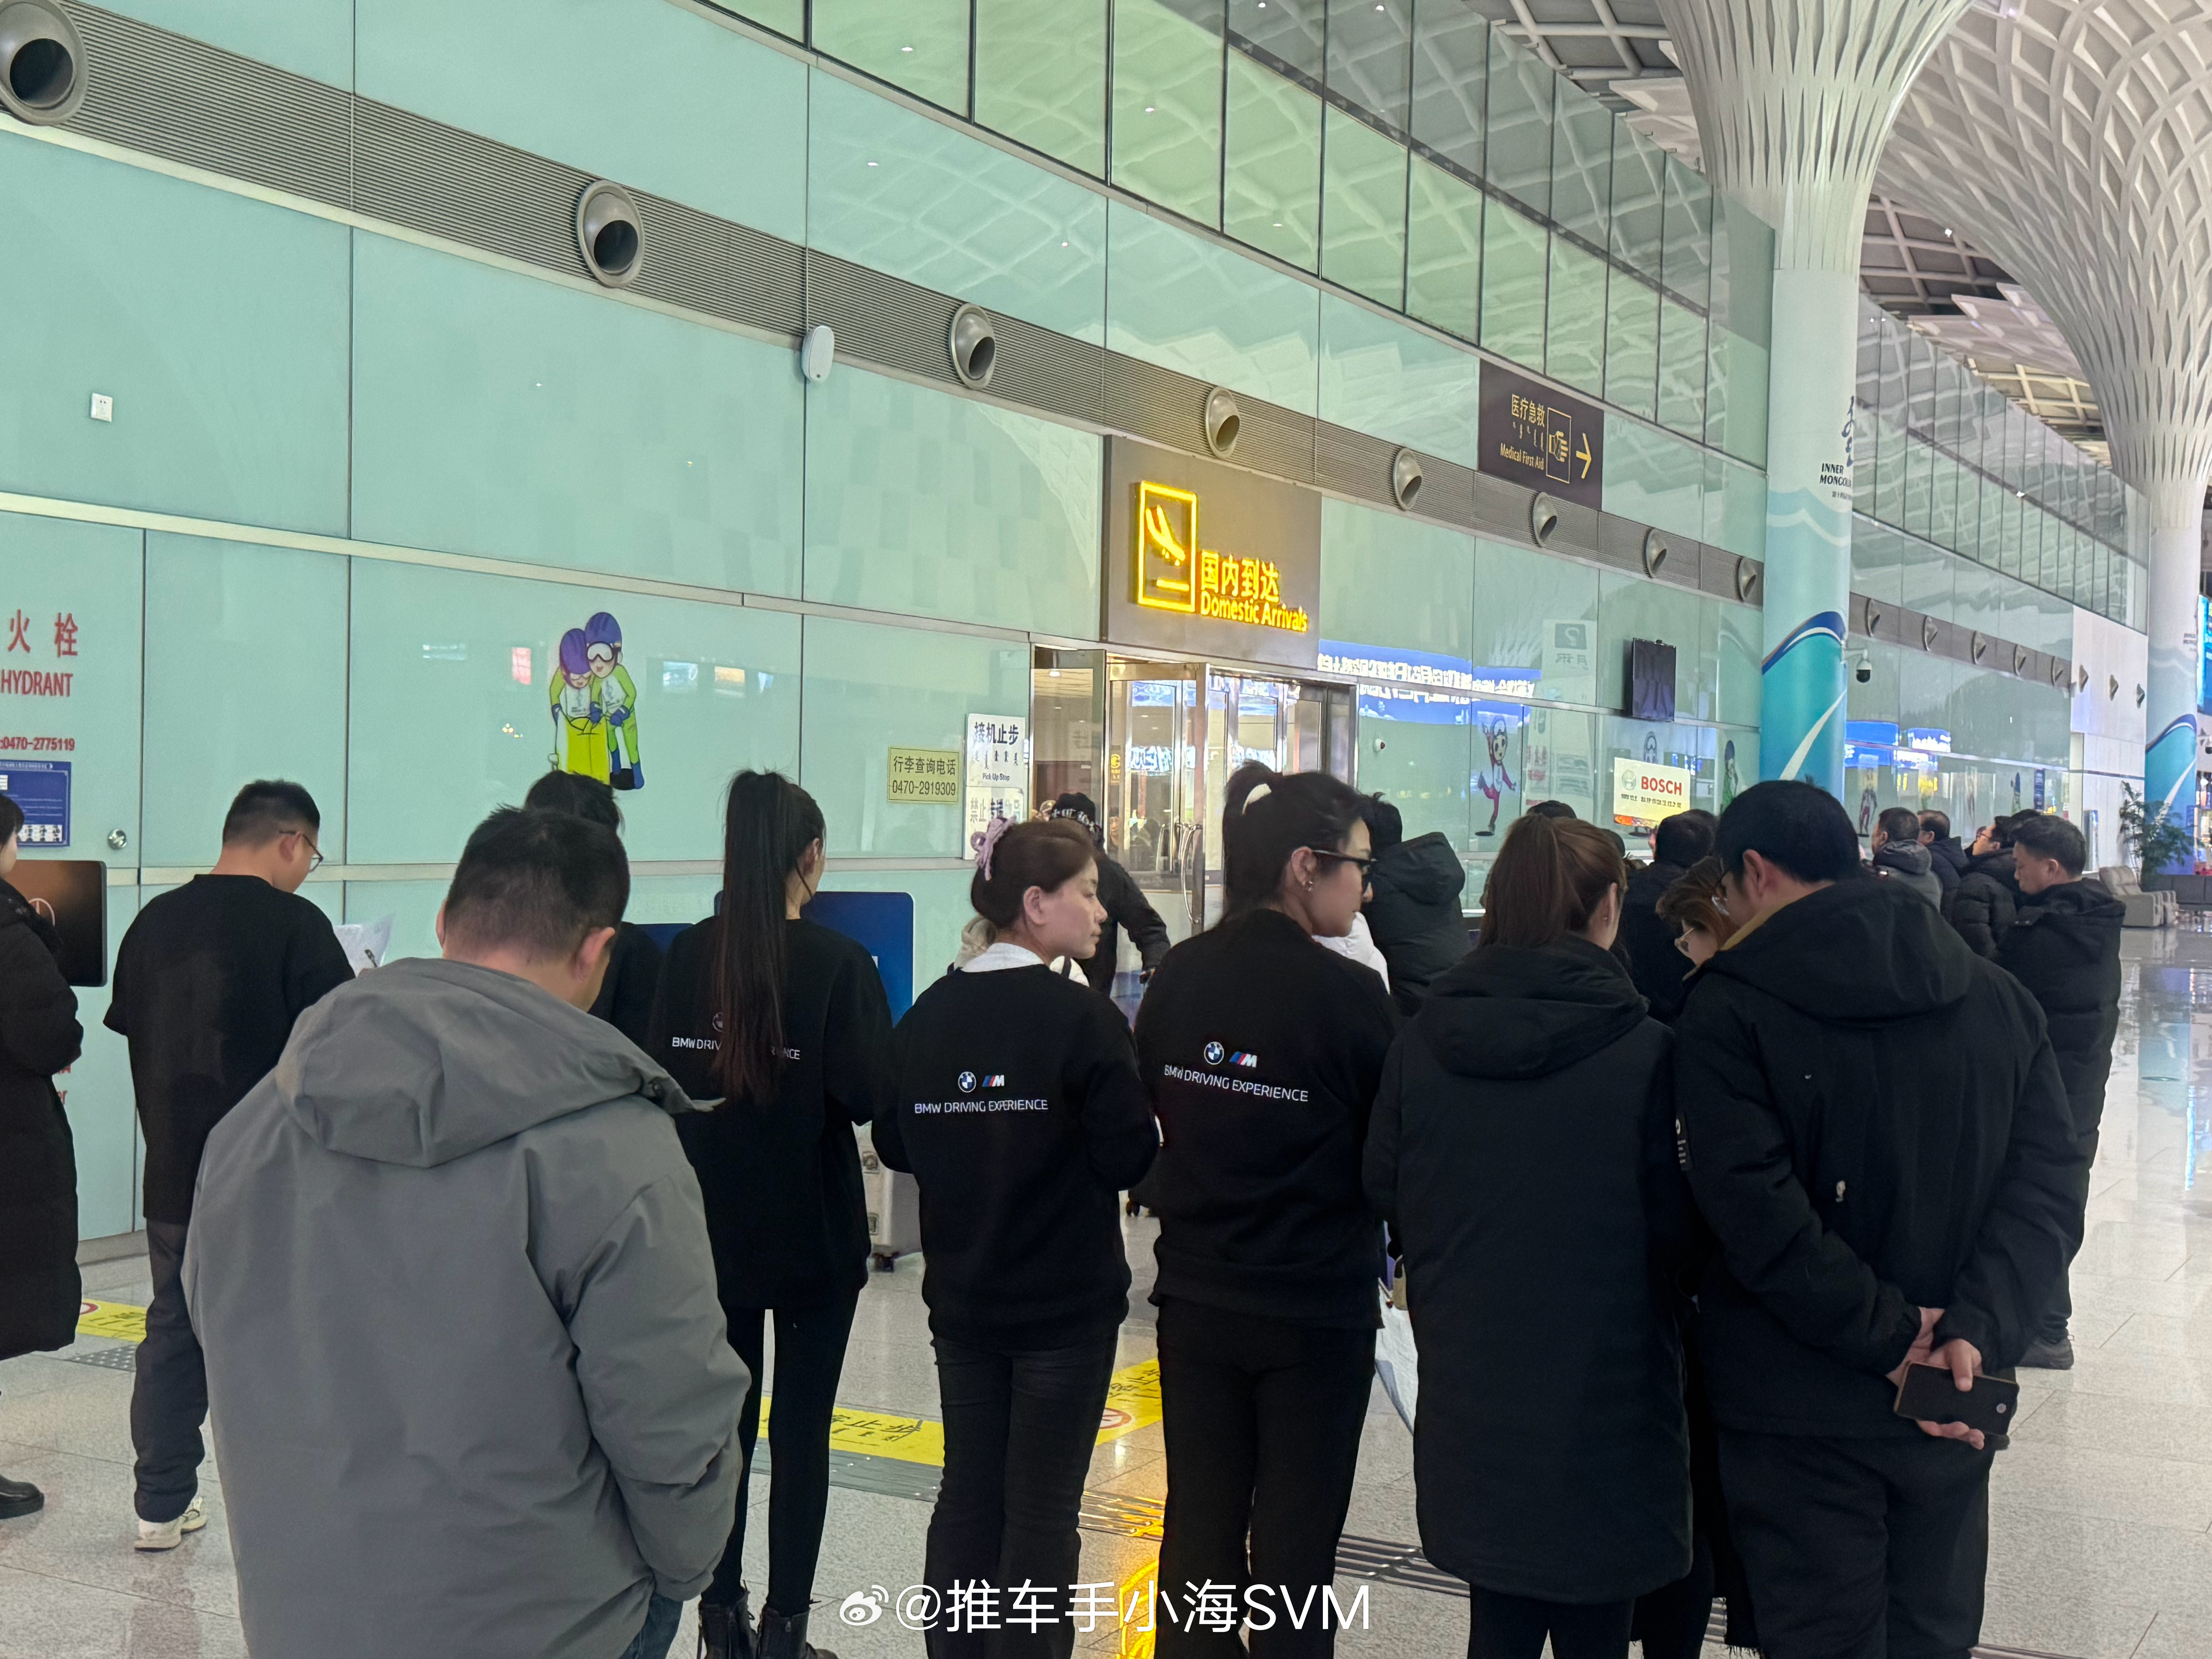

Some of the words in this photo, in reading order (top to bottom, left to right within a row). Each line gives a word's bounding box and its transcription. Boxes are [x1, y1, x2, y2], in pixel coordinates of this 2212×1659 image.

[1511, 394, 1545, 427] 医疗急救
[1500, 443, 1521, 463] Medical
[1522, 449, 1534, 467] First
[1535, 457, 1544, 470] Aid
[1822, 463, 1844, 474] INNER
[1201, 550, 1279, 603] 国内到达
[1200, 590, 1259, 623] Domestic
[1261, 603, 1308, 632] Arrivals
[1, 669, 73, 697] HYDRANT
[974, 722, 1019, 745] 接机止步
[893, 756, 956, 776] 行李查询电话
[993, 773, 999, 781] Up
[1000, 773, 1010, 781] Stop
[1641, 776, 1682, 796] BOSCH
[892, 780, 956, 796] 0470-2919309
[672, 1037, 696, 1049] BMW
[697, 1039, 722, 1050] DRIV
[1164, 1065, 1184, 1079] BMW
[1184, 1070, 1230, 1090] DRIVING
[1232, 1080, 1309, 1102] EXPERIENCE
[915, 1103, 941, 1114] BMW
[945, 1101, 986, 1113] DRIVING
[989, 1099, 1049, 1112] EXPERIENCE
